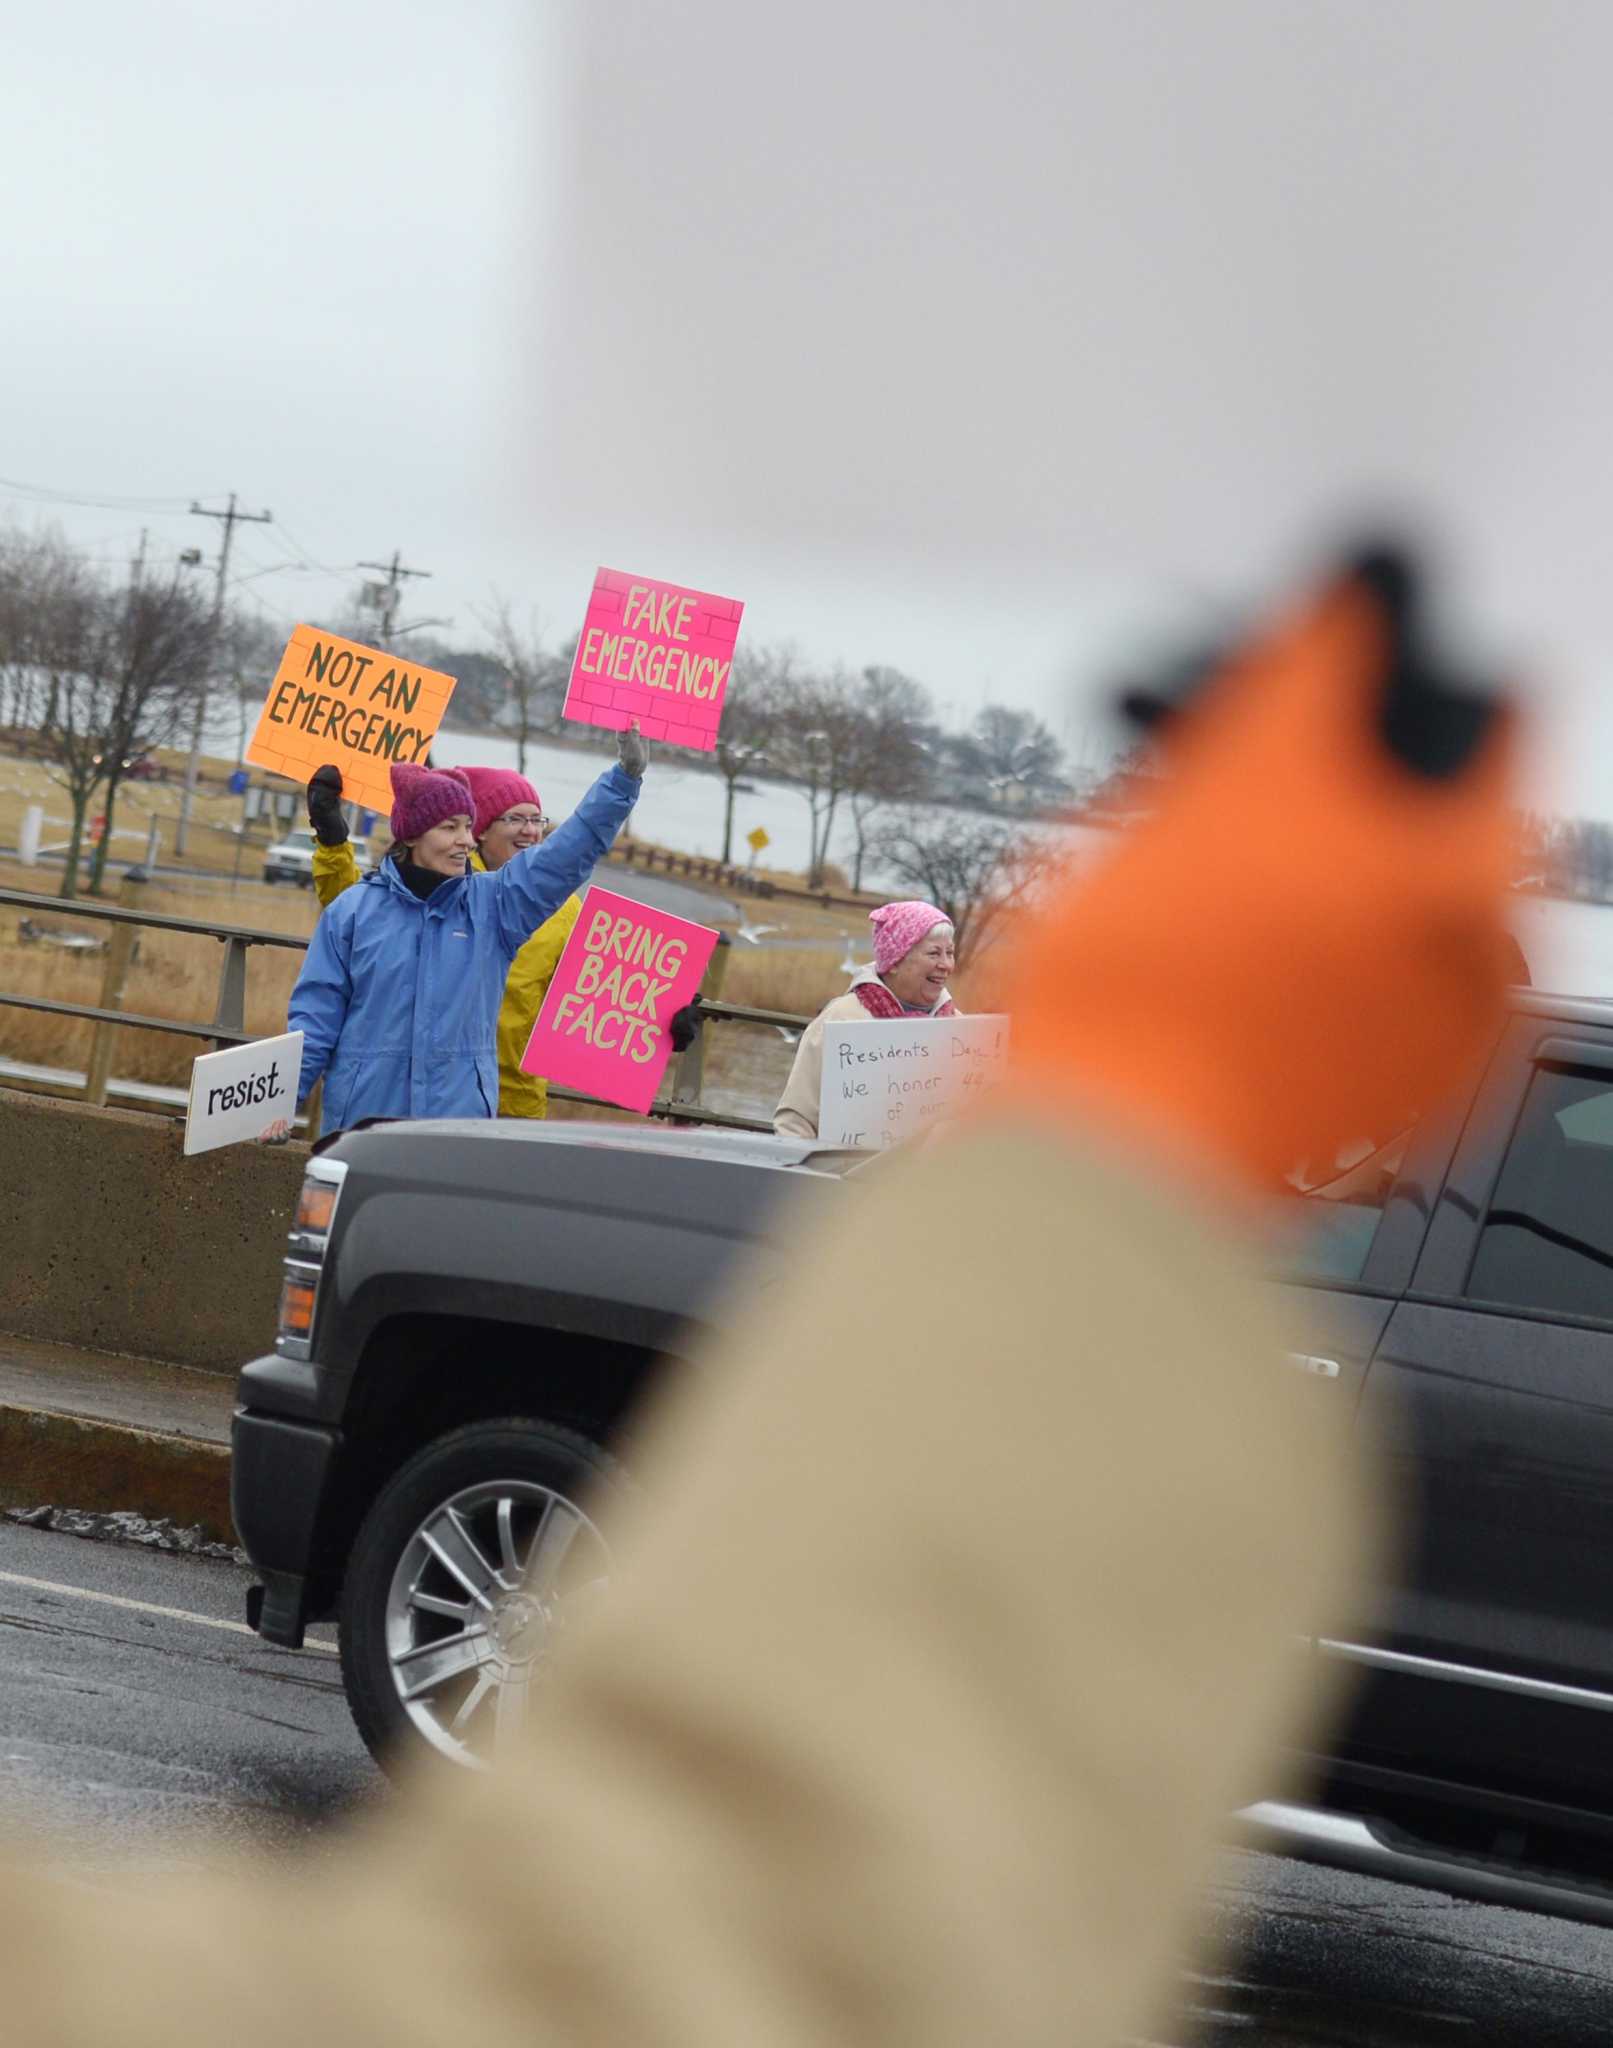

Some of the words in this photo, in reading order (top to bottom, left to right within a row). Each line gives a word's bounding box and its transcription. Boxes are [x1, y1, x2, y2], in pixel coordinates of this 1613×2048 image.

[622, 584, 697, 641] FAKE
[305, 642, 374, 696] NOT
[369, 668, 422, 714] AN
[580, 627, 730, 701] EMERGENCY
[268, 681, 433, 763] EMERGENCY
[583, 909, 688, 979] BRING
[575, 953, 672, 1020] BACK
[551, 992, 662, 1064] FACTS
[838, 1040, 930, 1069] Presidents
[207, 1061, 285, 1116] resist.
[842, 1082, 869, 1100] We
[887, 1074, 942, 1095] honor
